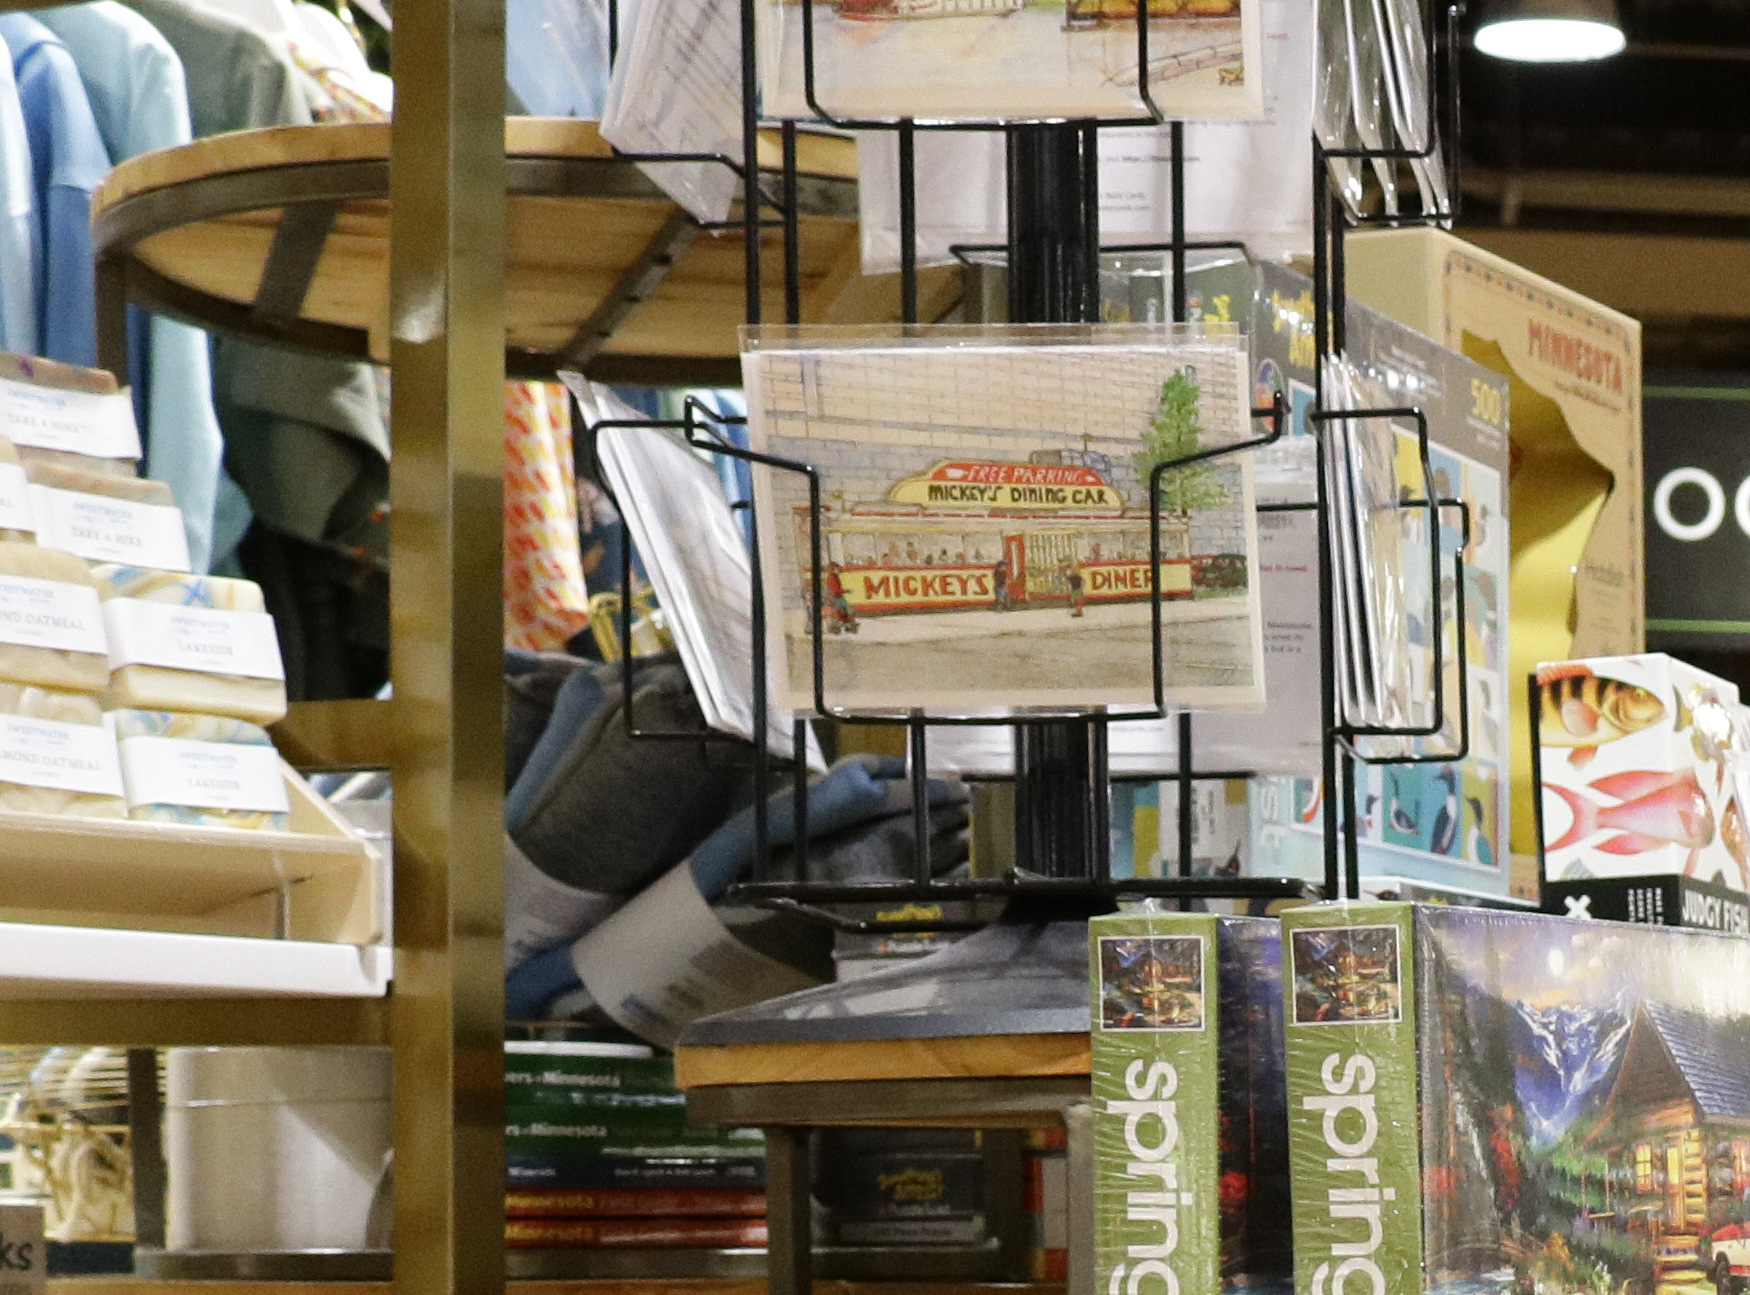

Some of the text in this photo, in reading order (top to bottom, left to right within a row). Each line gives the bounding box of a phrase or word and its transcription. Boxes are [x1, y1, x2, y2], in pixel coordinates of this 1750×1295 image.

[969, 463, 1007, 483] FREE
[928, 484, 999, 504] MICKEY'S
[1072, 488, 1107, 505] CAR
[1681, 890, 1722, 929] JUDGY
